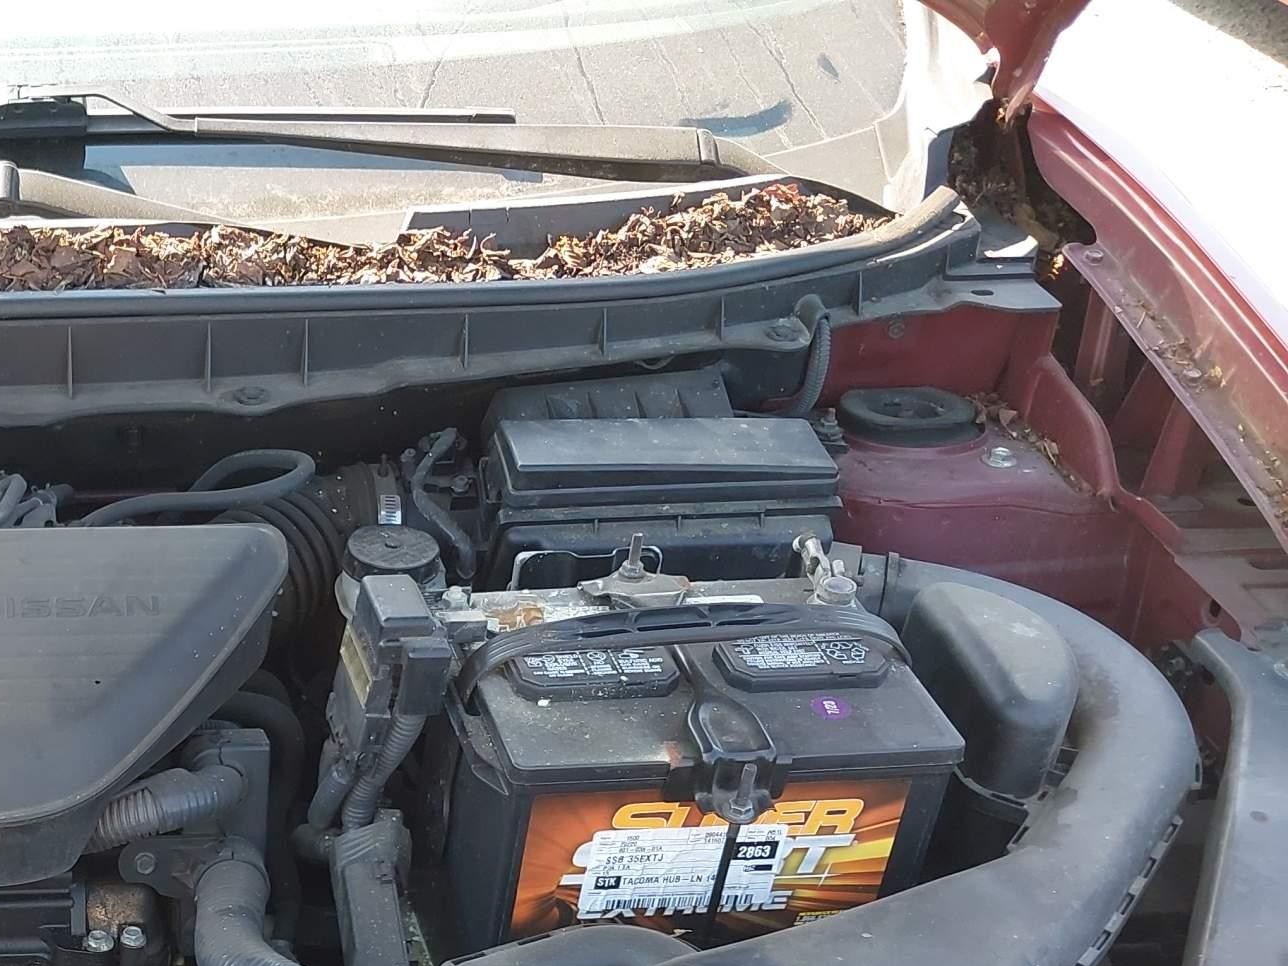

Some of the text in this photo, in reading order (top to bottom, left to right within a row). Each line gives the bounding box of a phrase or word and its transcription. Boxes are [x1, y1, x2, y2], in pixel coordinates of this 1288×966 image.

[737, 845, 771, 858] 2863
[596, 877, 617, 888] STK
[622, 878, 660, 886] TACOMA
